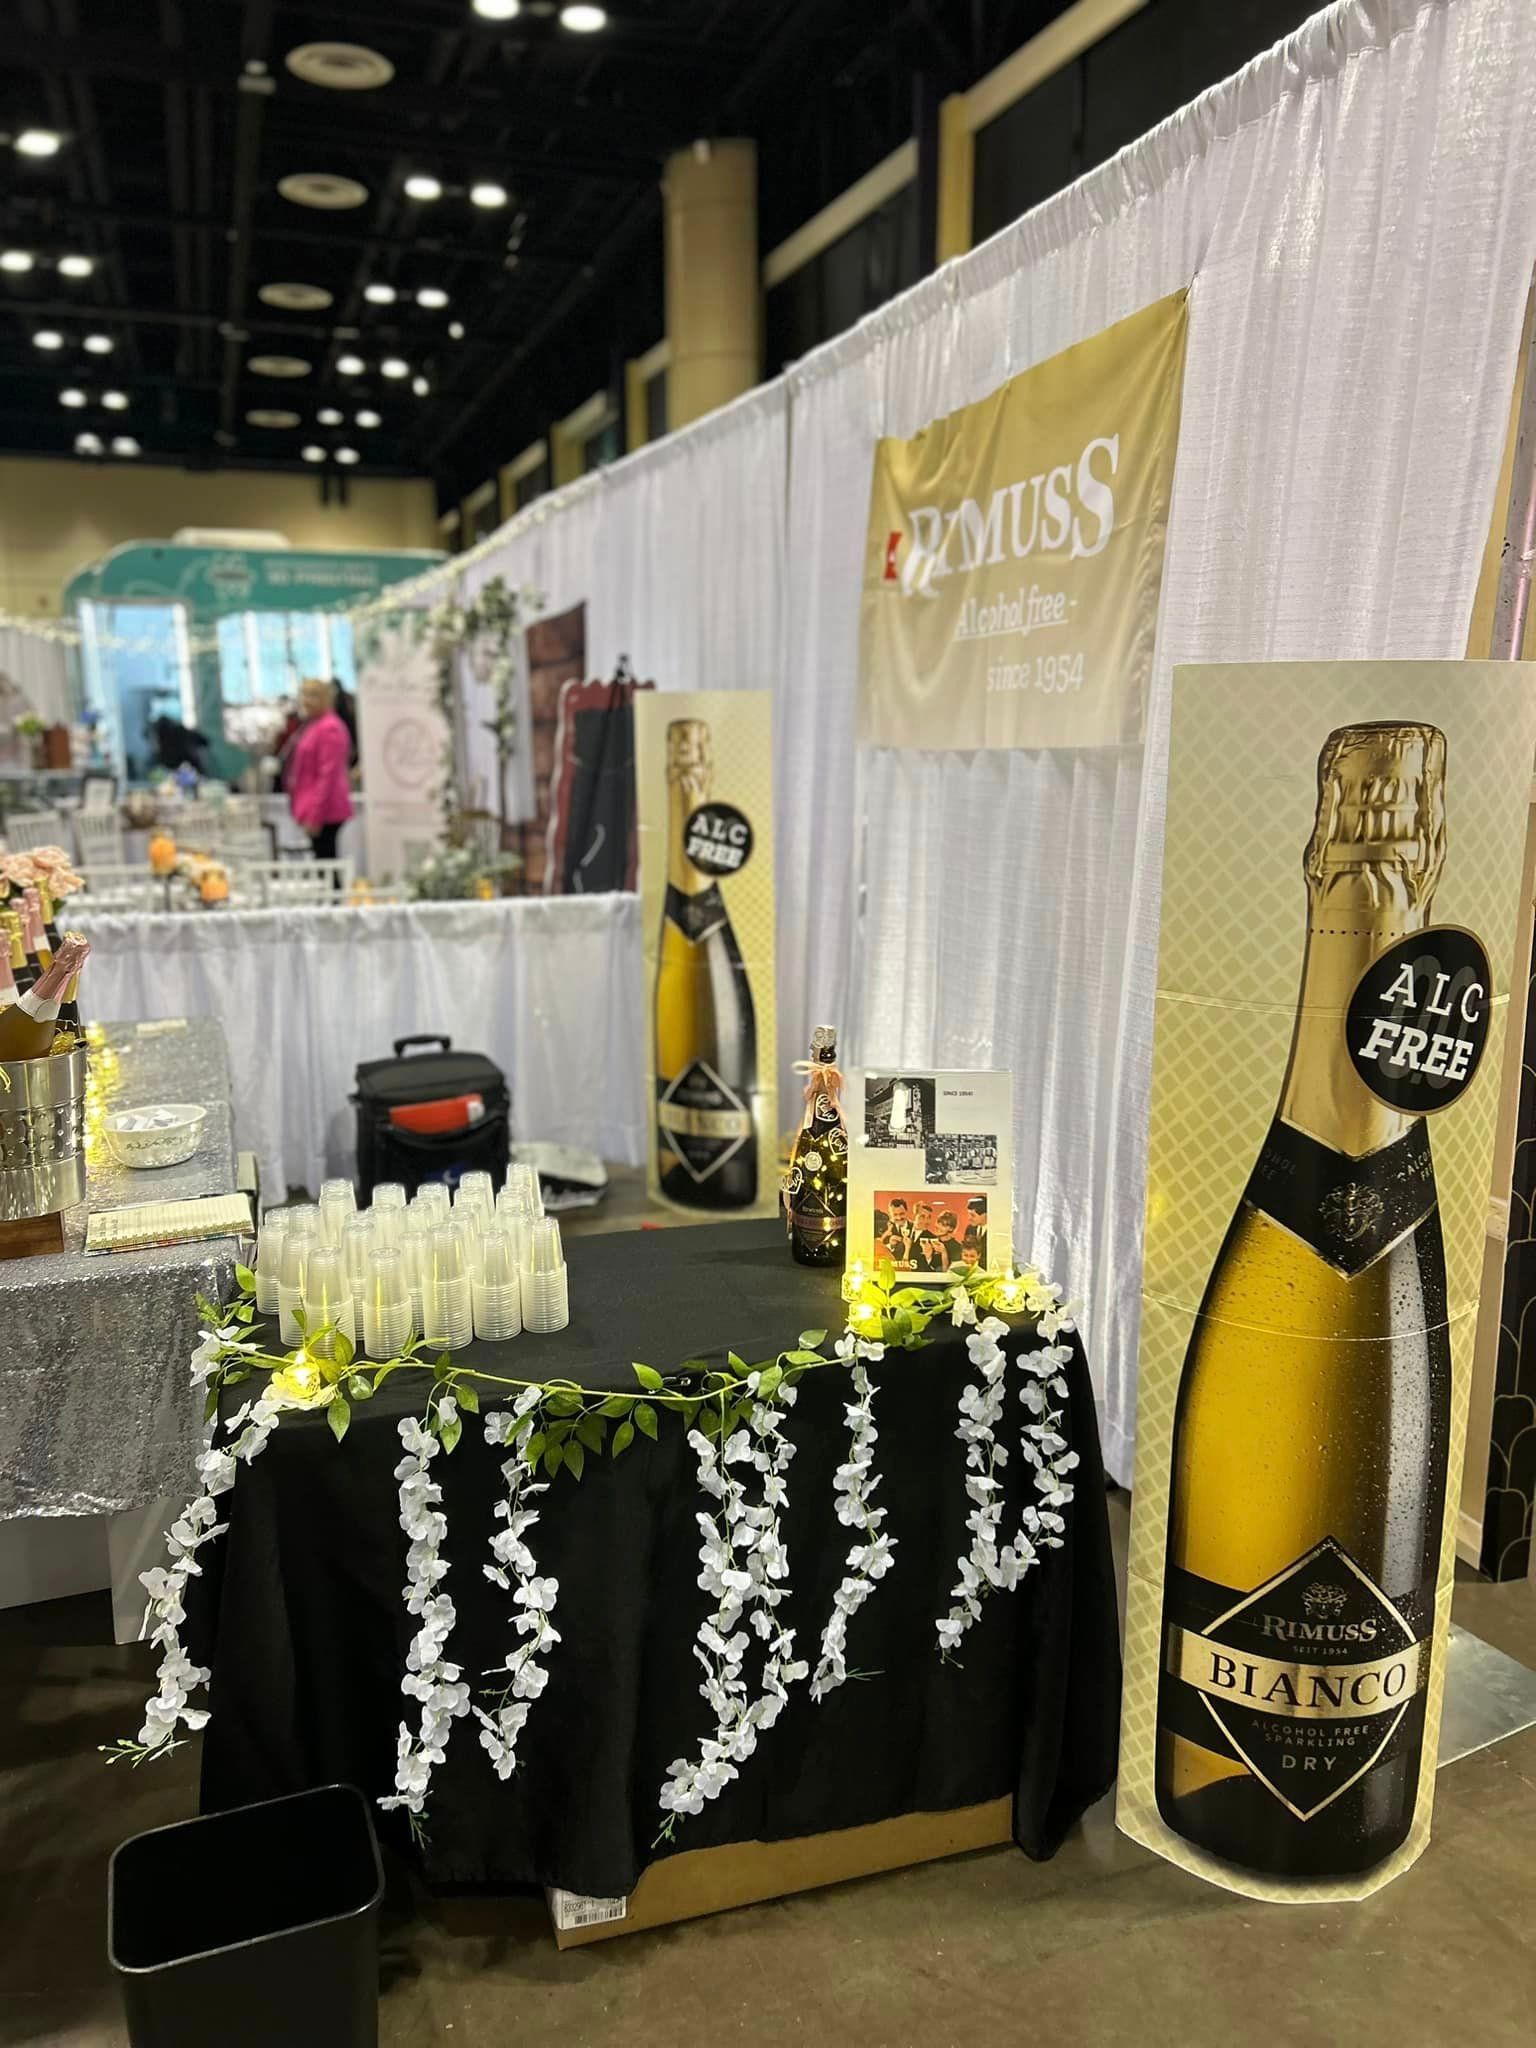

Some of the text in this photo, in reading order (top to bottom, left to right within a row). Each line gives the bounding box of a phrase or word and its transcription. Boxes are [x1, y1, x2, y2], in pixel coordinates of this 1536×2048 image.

[902, 433, 1120, 597] RIMUSS
[957, 587, 1025, 637] Alcohol
[1023, 584, 1066, 636] free
[987, 652, 1084, 694] since 1954
[691, 813, 748, 846] ALC
[687, 836, 744, 869] FREE
[1379, 962, 1484, 1023] ALC
[1358, 1018, 1474, 1081] FREE
[1262, 1614, 1377, 1642] RIMUSS
[1208, 1652, 1407, 1708] BIANCO
[1251, 1720, 1369, 1737] ALCOHOL FREE
[1265, 1732, 1356, 1747] SPARKLING
[1282, 1754, 1337, 1771] DRY
